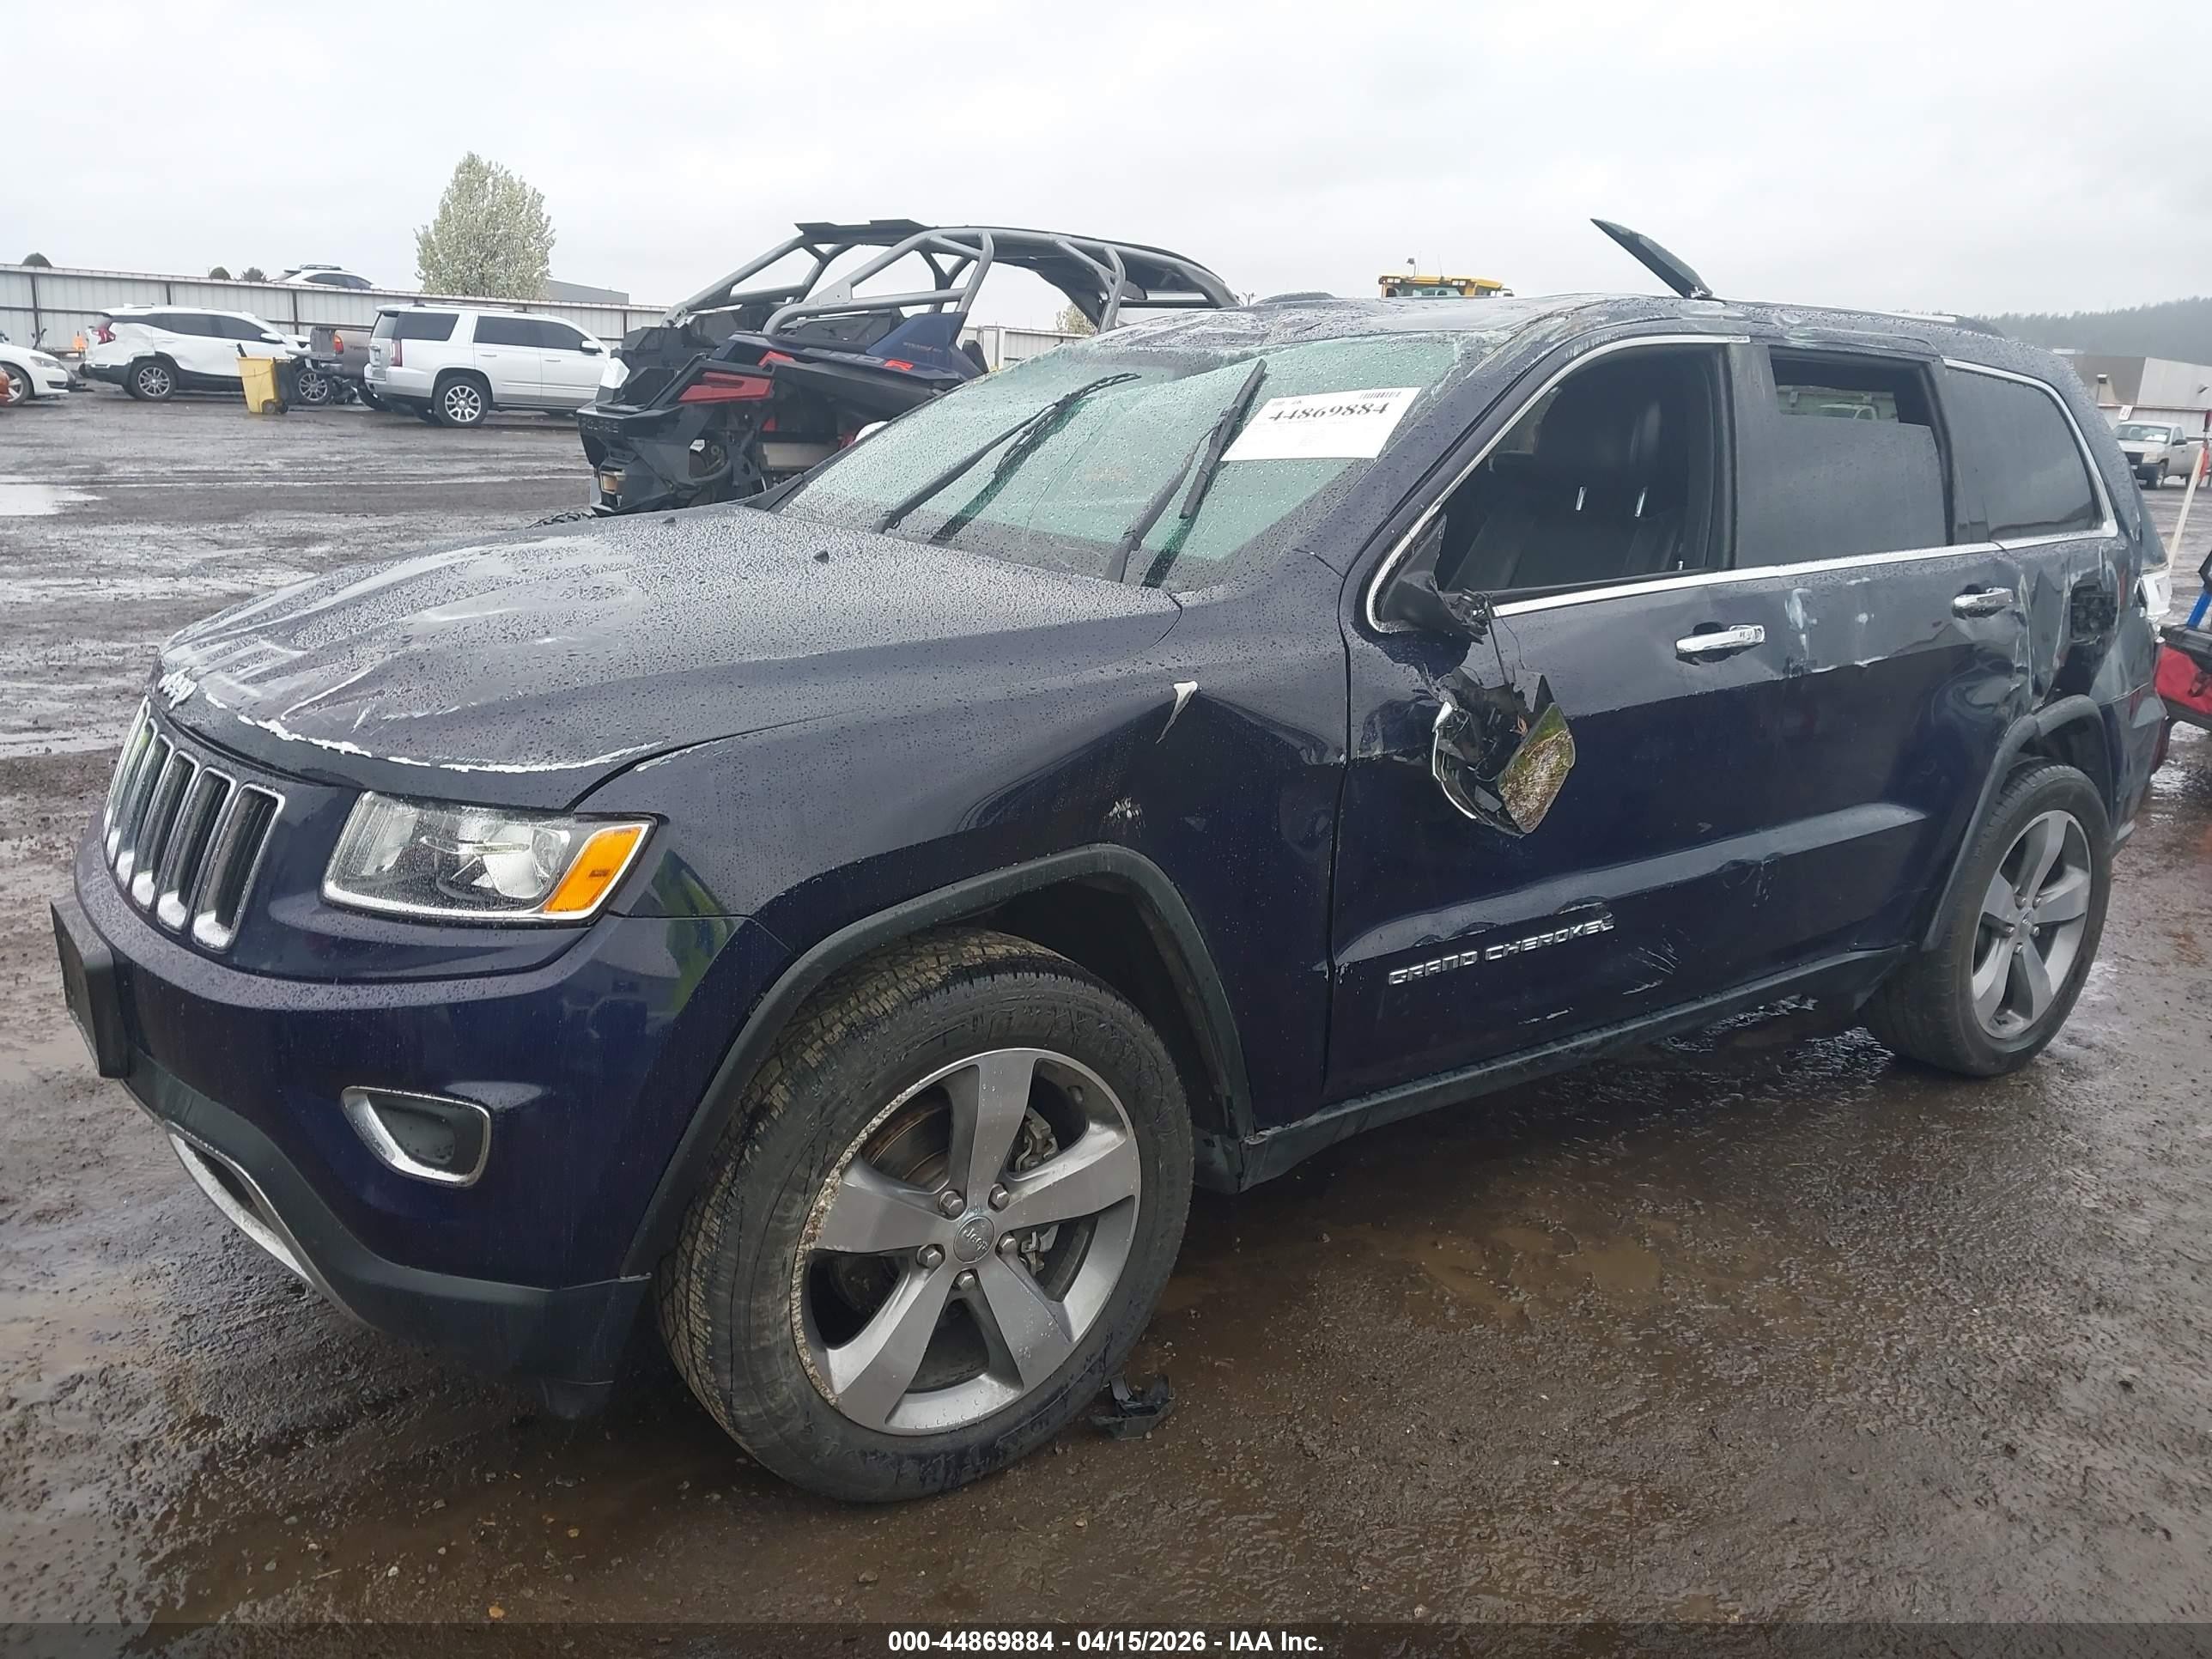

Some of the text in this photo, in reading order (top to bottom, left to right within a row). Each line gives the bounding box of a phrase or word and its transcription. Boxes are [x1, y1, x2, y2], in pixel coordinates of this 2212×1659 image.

[1267, 401, 1390, 422] 44869884
[1388, 950, 1478, 986] GRAND
[963, 1228, 988, 1251] Jeep
